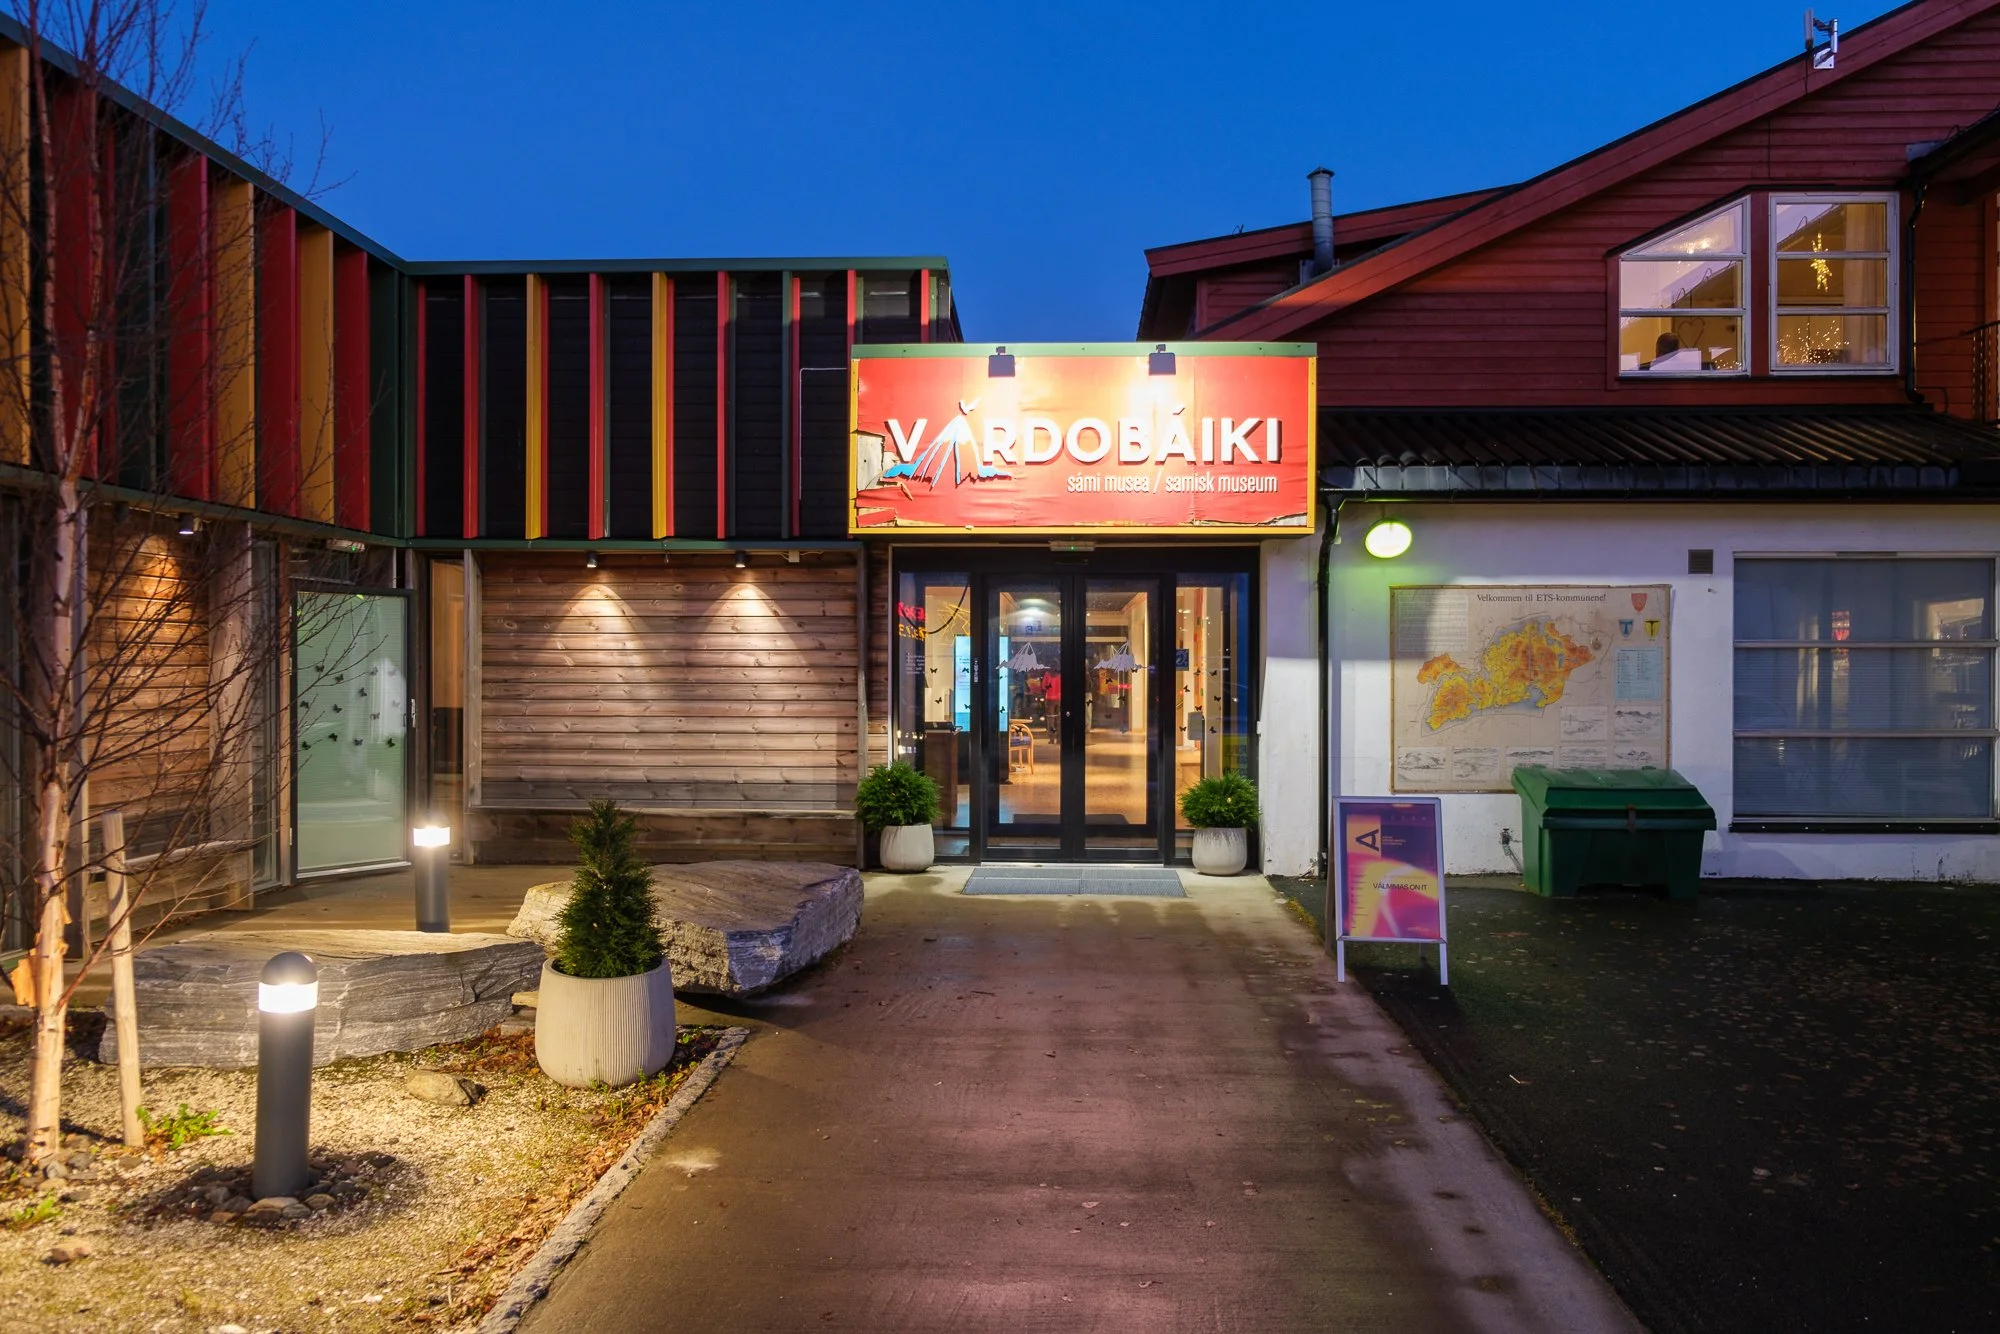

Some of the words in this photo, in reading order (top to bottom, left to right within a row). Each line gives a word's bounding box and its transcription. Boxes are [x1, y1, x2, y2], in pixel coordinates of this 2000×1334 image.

[1067, 473, 1100, 493] sámi
[1104, 476, 1150, 493] musea
[1165, 472, 1215, 493] samisk
[1218, 476, 1279, 493] museum
[1476, 594, 1522, 602] Velkommen
[1525, 594, 1533, 602] til
[1536, 594, 1607, 602] ETS-kommunene!
